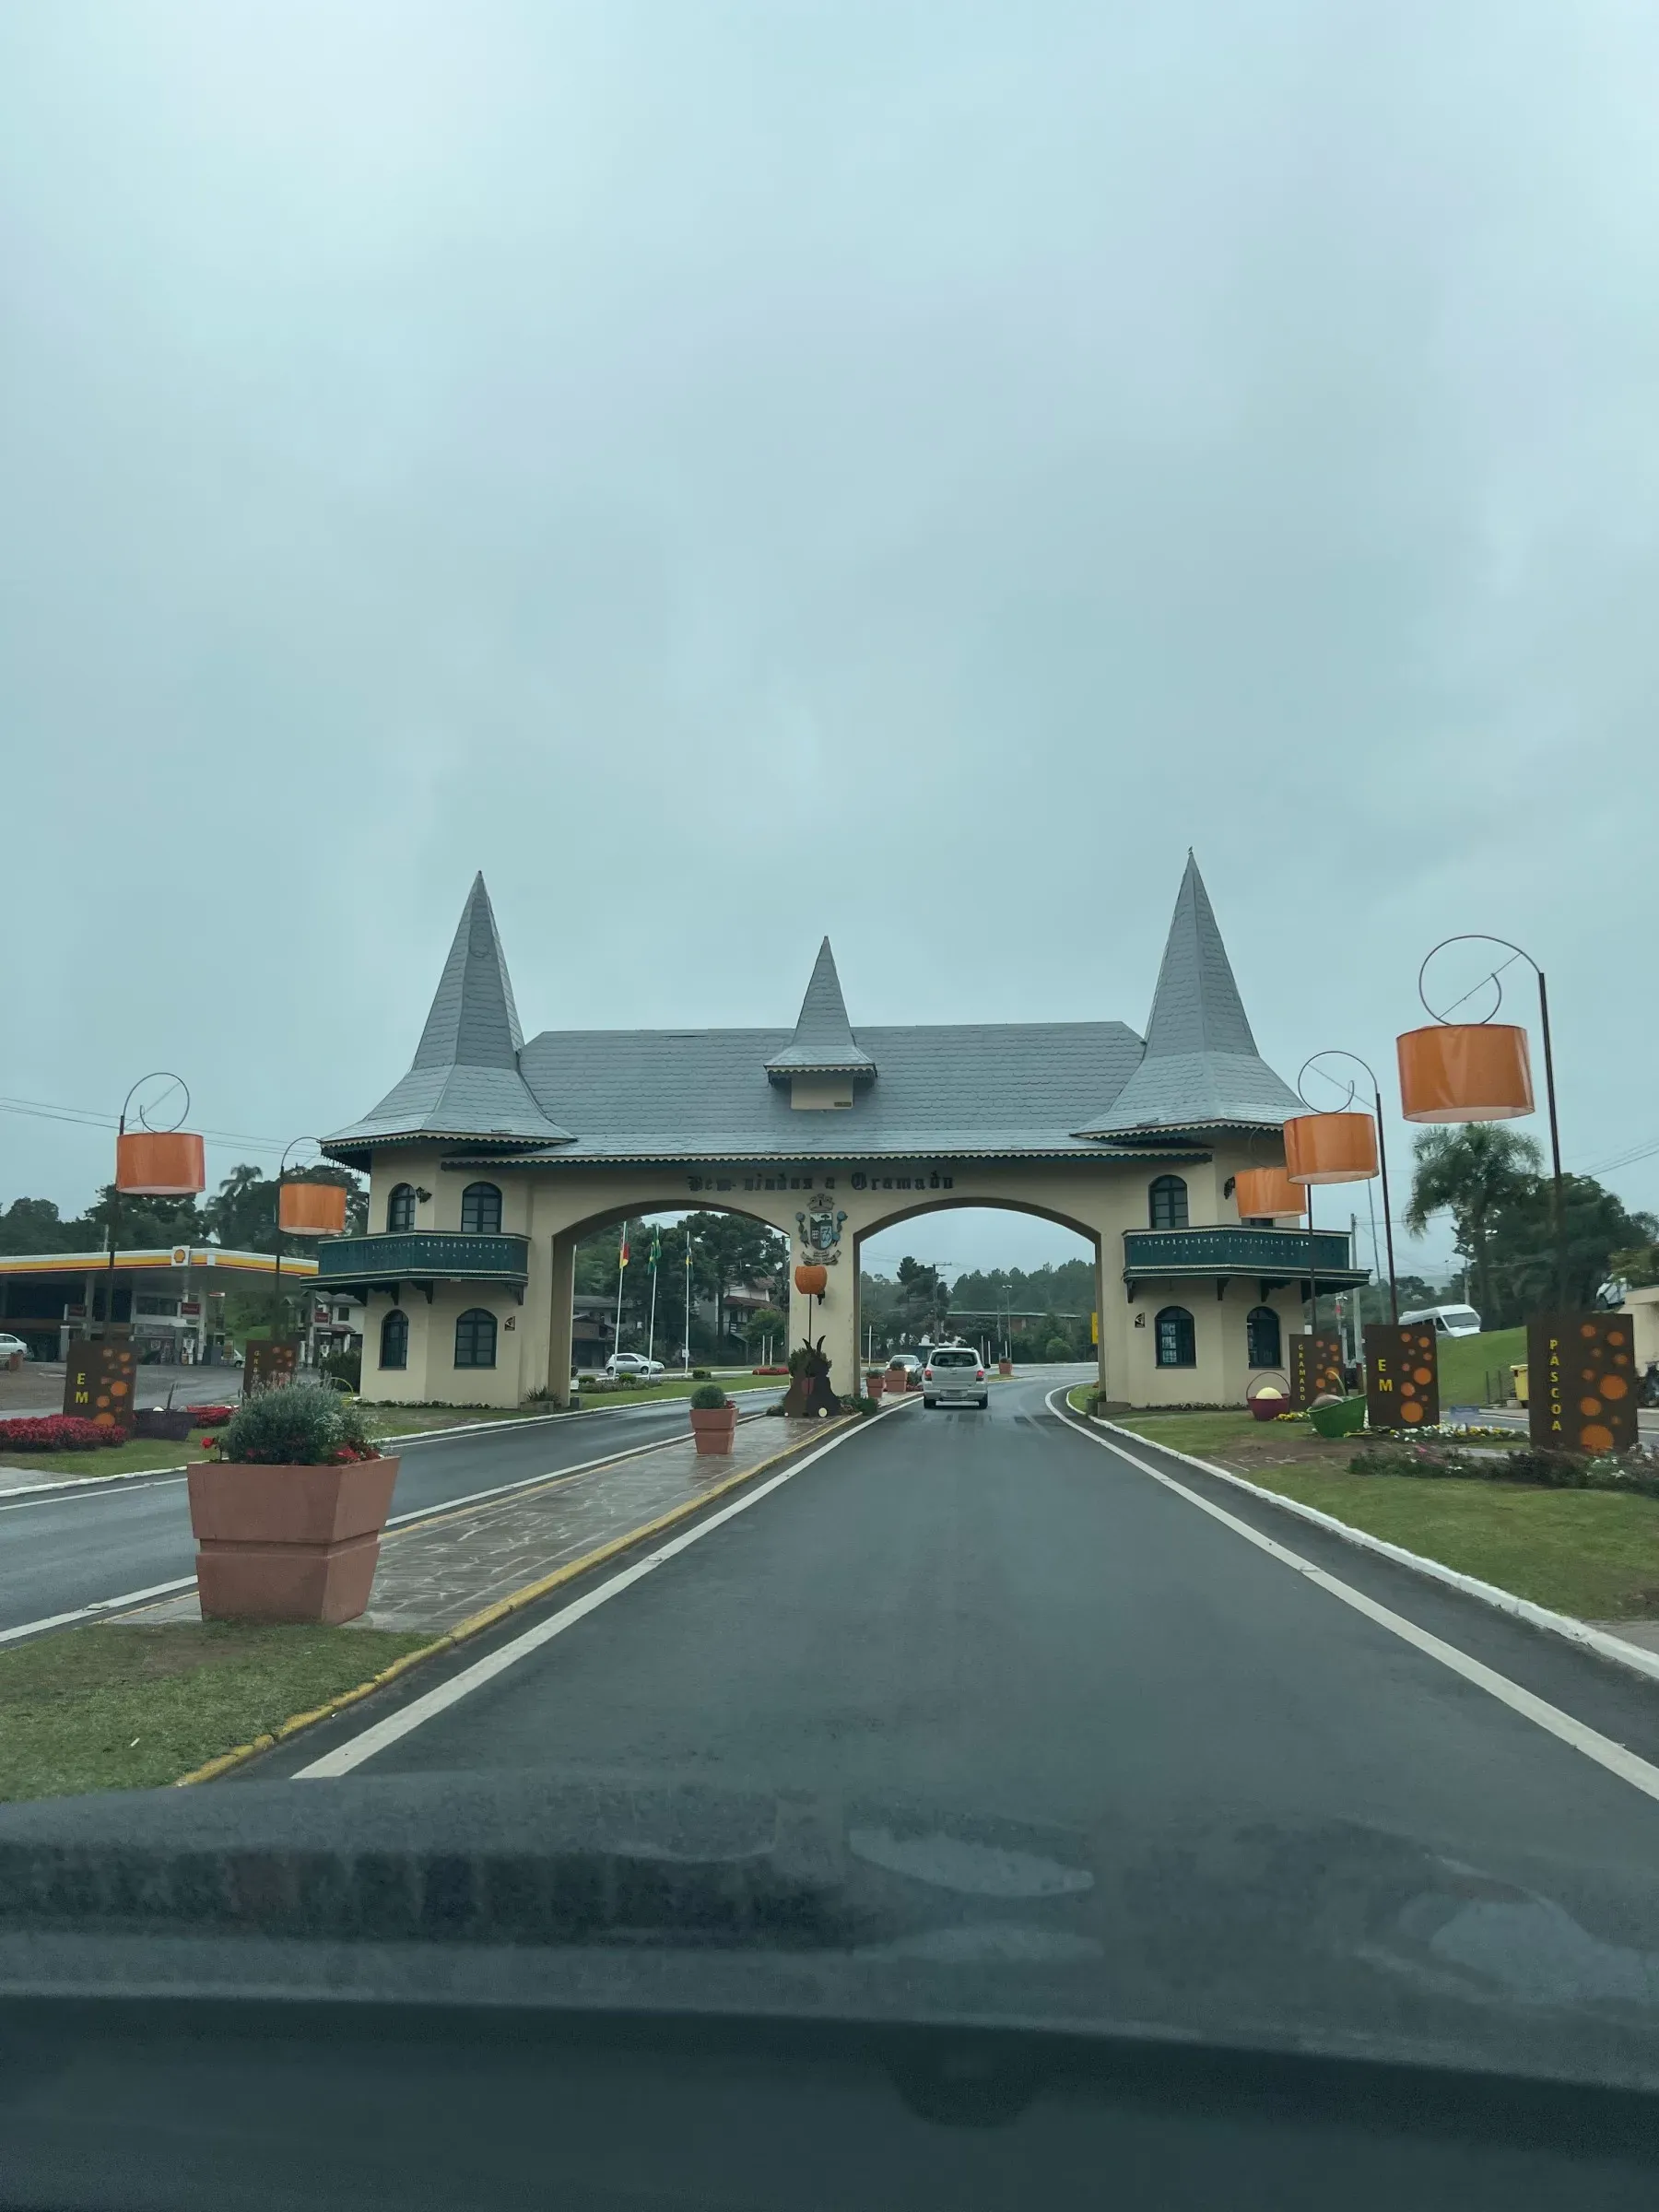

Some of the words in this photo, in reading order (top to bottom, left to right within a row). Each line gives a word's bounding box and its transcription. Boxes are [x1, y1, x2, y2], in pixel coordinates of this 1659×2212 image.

[850, 1171, 954, 1191] Gramado
[75, 1372, 89, 1404] EM
[1298, 1344, 1306, 1401] GRAMADO
[1378, 1359, 1394, 1392] EM
